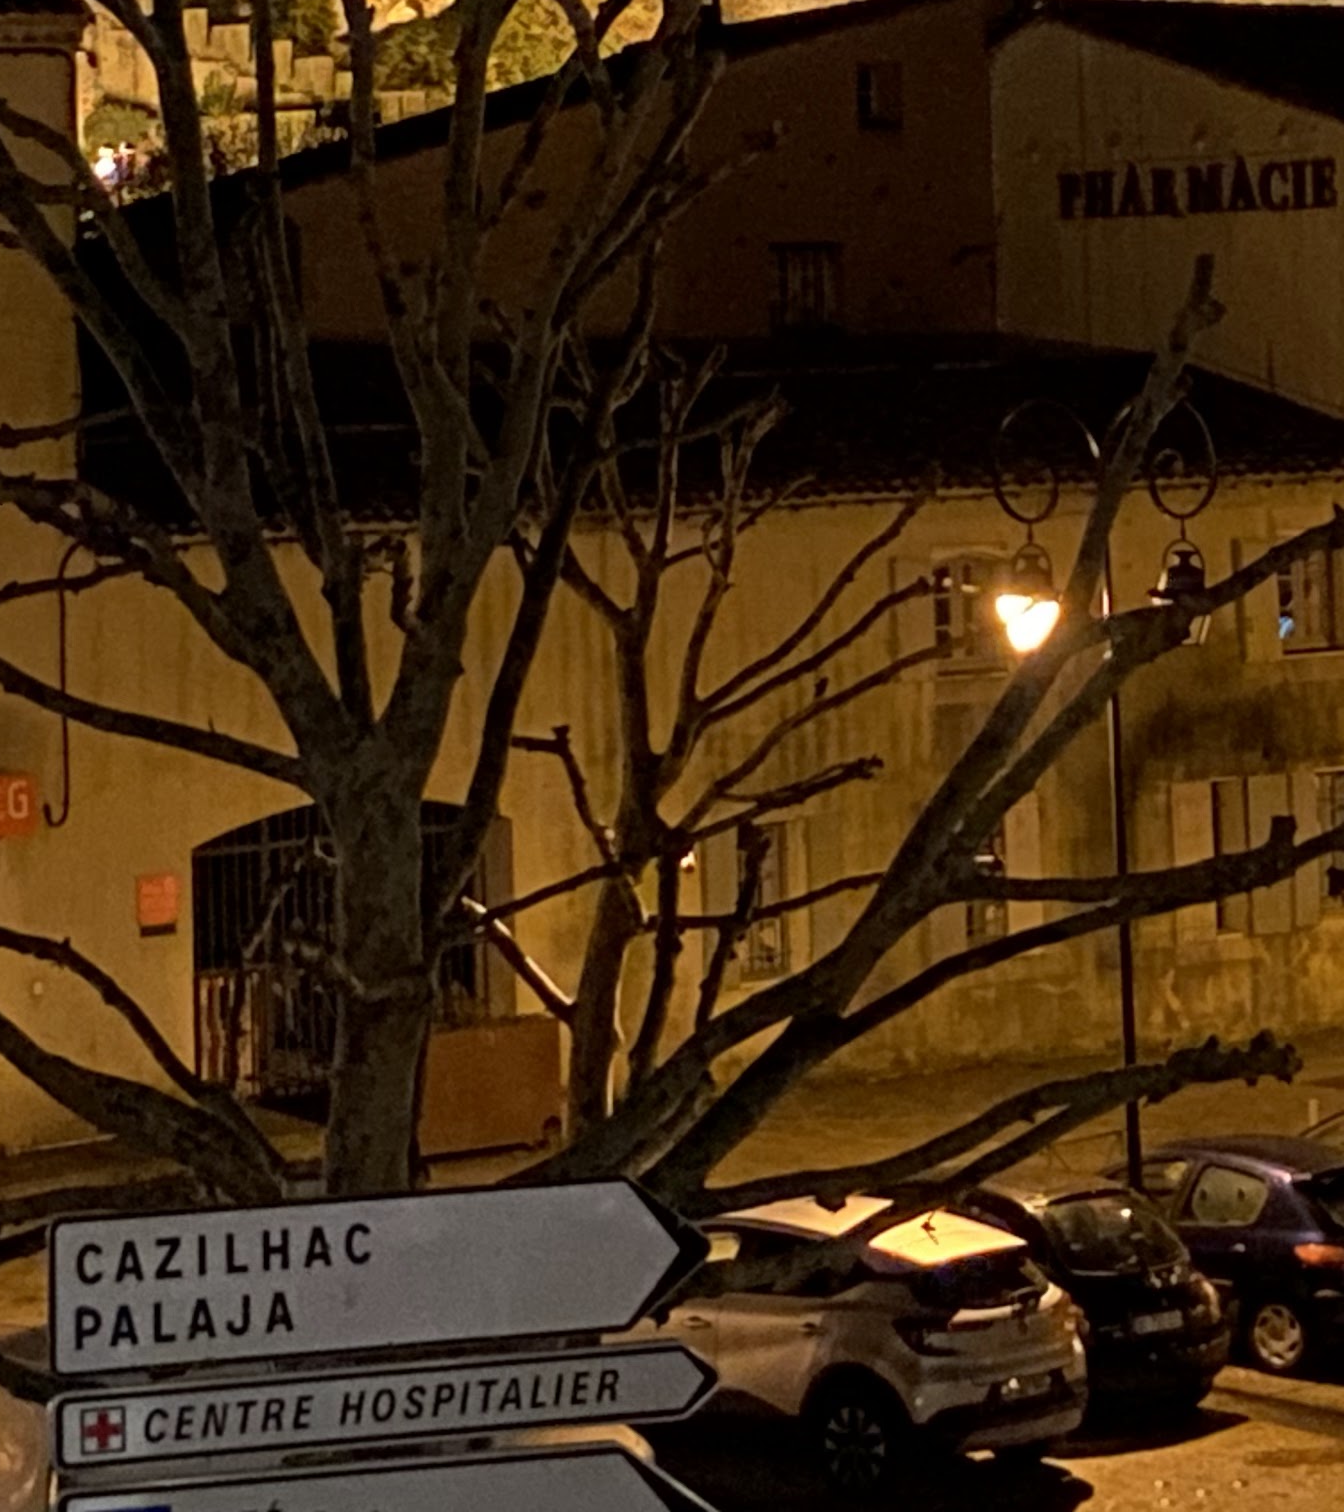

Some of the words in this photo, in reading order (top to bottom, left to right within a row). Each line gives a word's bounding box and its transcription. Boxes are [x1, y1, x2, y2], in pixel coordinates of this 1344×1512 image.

[1057, 154, 1338, 220] PHARMACIE
[75, 1223, 373, 1285] CAZILHAC
[73, 1291, 295, 1350] PALAJA
[142, 1393, 313, 1445] CENTRE
[338, 1368, 621, 1428] HOSPITALIER
